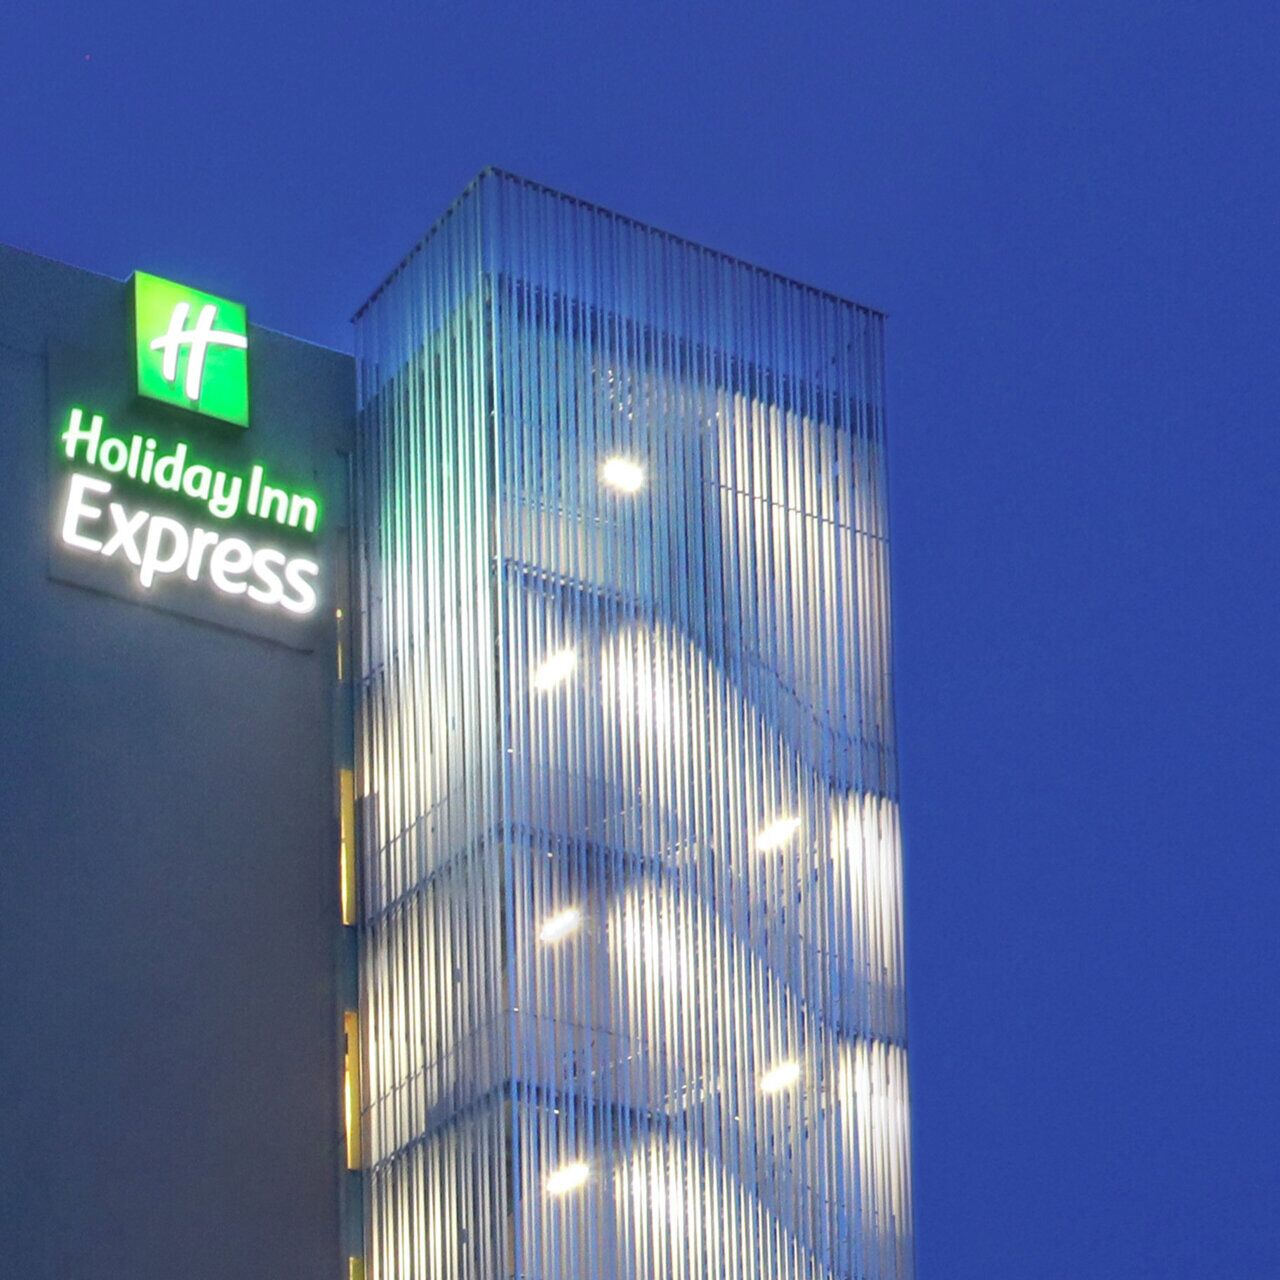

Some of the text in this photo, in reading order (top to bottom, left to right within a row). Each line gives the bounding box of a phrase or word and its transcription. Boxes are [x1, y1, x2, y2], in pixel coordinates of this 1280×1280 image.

[61, 408, 318, 533] Holiday Inn
[61, 473, 320, 615] Express
